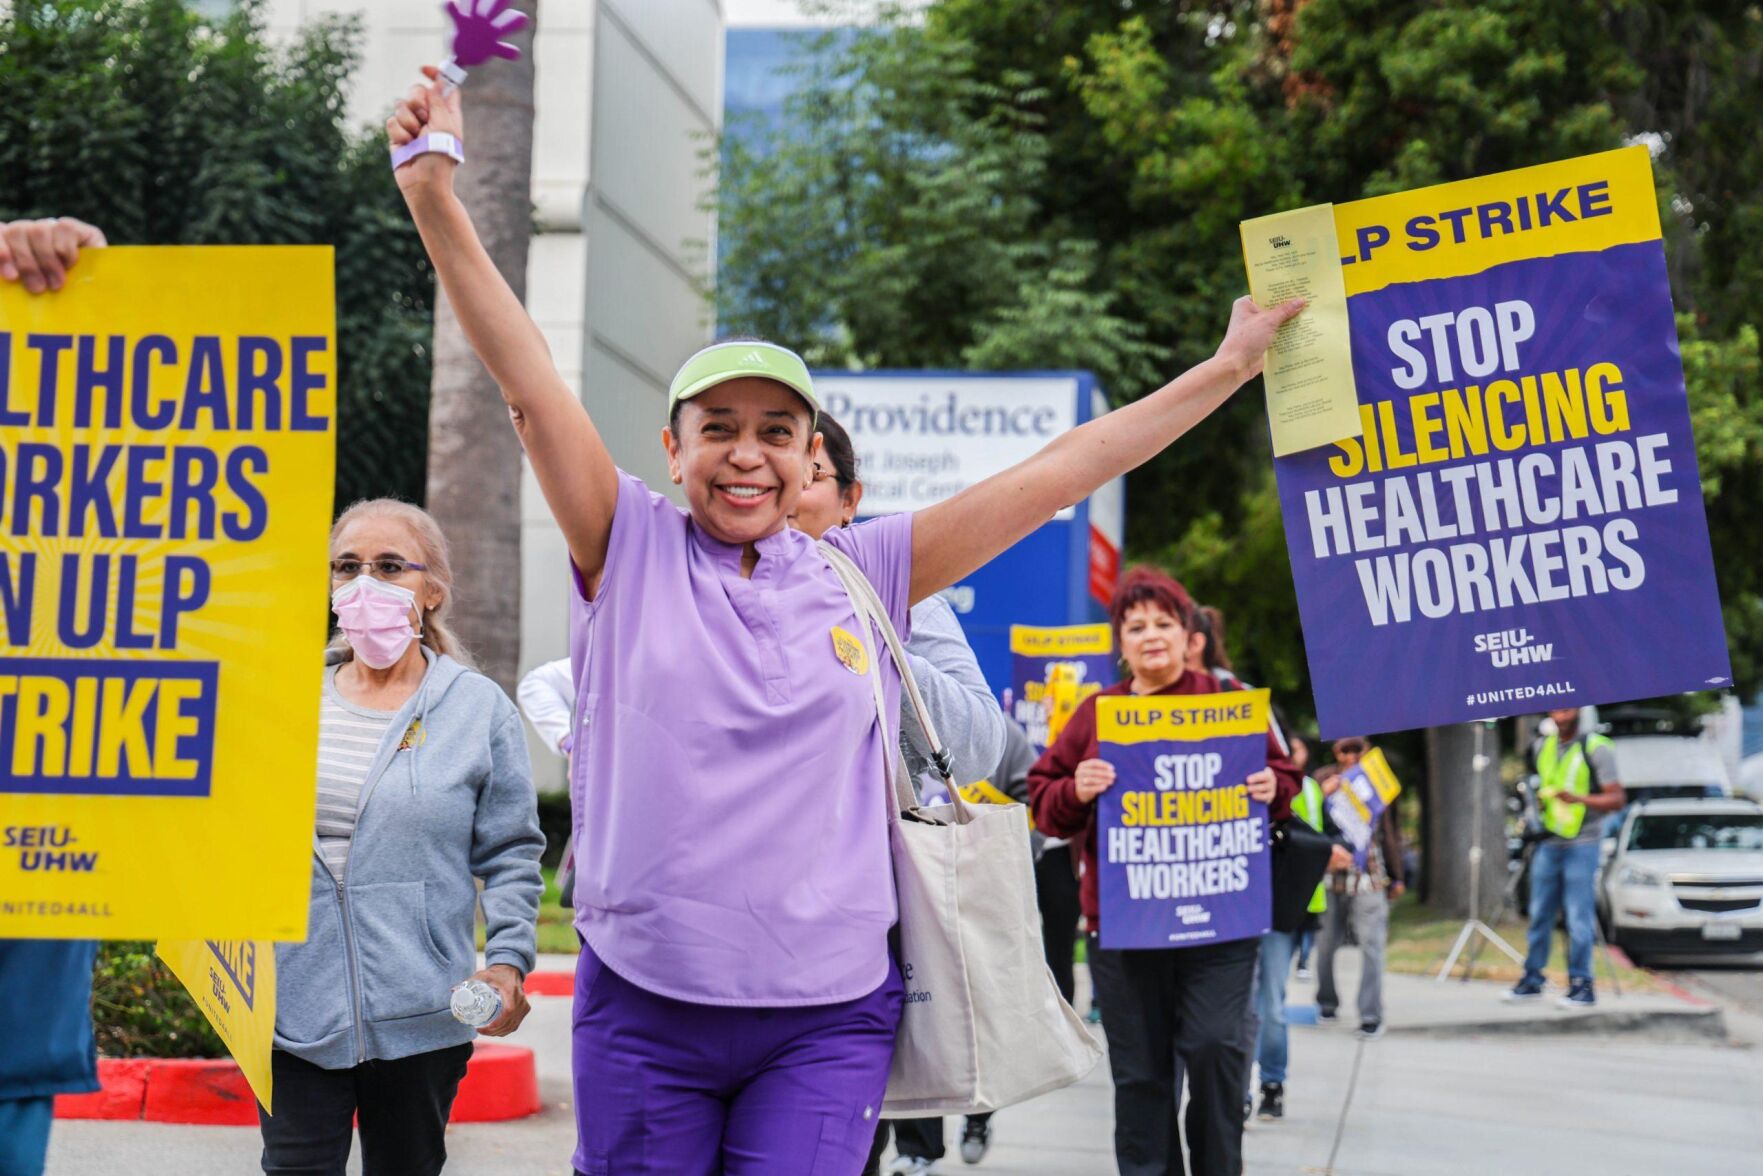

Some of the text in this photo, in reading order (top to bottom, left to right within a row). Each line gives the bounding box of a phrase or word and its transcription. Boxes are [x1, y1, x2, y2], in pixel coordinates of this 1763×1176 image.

[1405, 180, 1613, 252] STRIKE
[1273, 239, 1291, 249] UHW
[1387, 299, 1536, 391] STOP
[826, 391, 1056, 436] Providence
[0, 441, 270, 542] RKERS
[1304, 432, 1679, 559] HEALTHCARE
[1355, 518, 1646, 627] WORKERS
[57, 553, 211, 649] ULP
[1474, 628, 1535, 652] SEIU-
[1491, 643, 1554, 668] UHW
[1115, 703, 1253, 726] ULP STRIKE
[1466, 681, 1576, 707] #UNITED4ALL
[1154, 752, 1223, 791] STOP
[1121, 784, 1250, 827] SILENCING
[4, 826, 78, 848] SEIU-
[1107, 817, 1264, 864] HEALTHCARE
[20, 851, 99, 872] UHW
[1126, 856, 1250, 900] WORKERS
